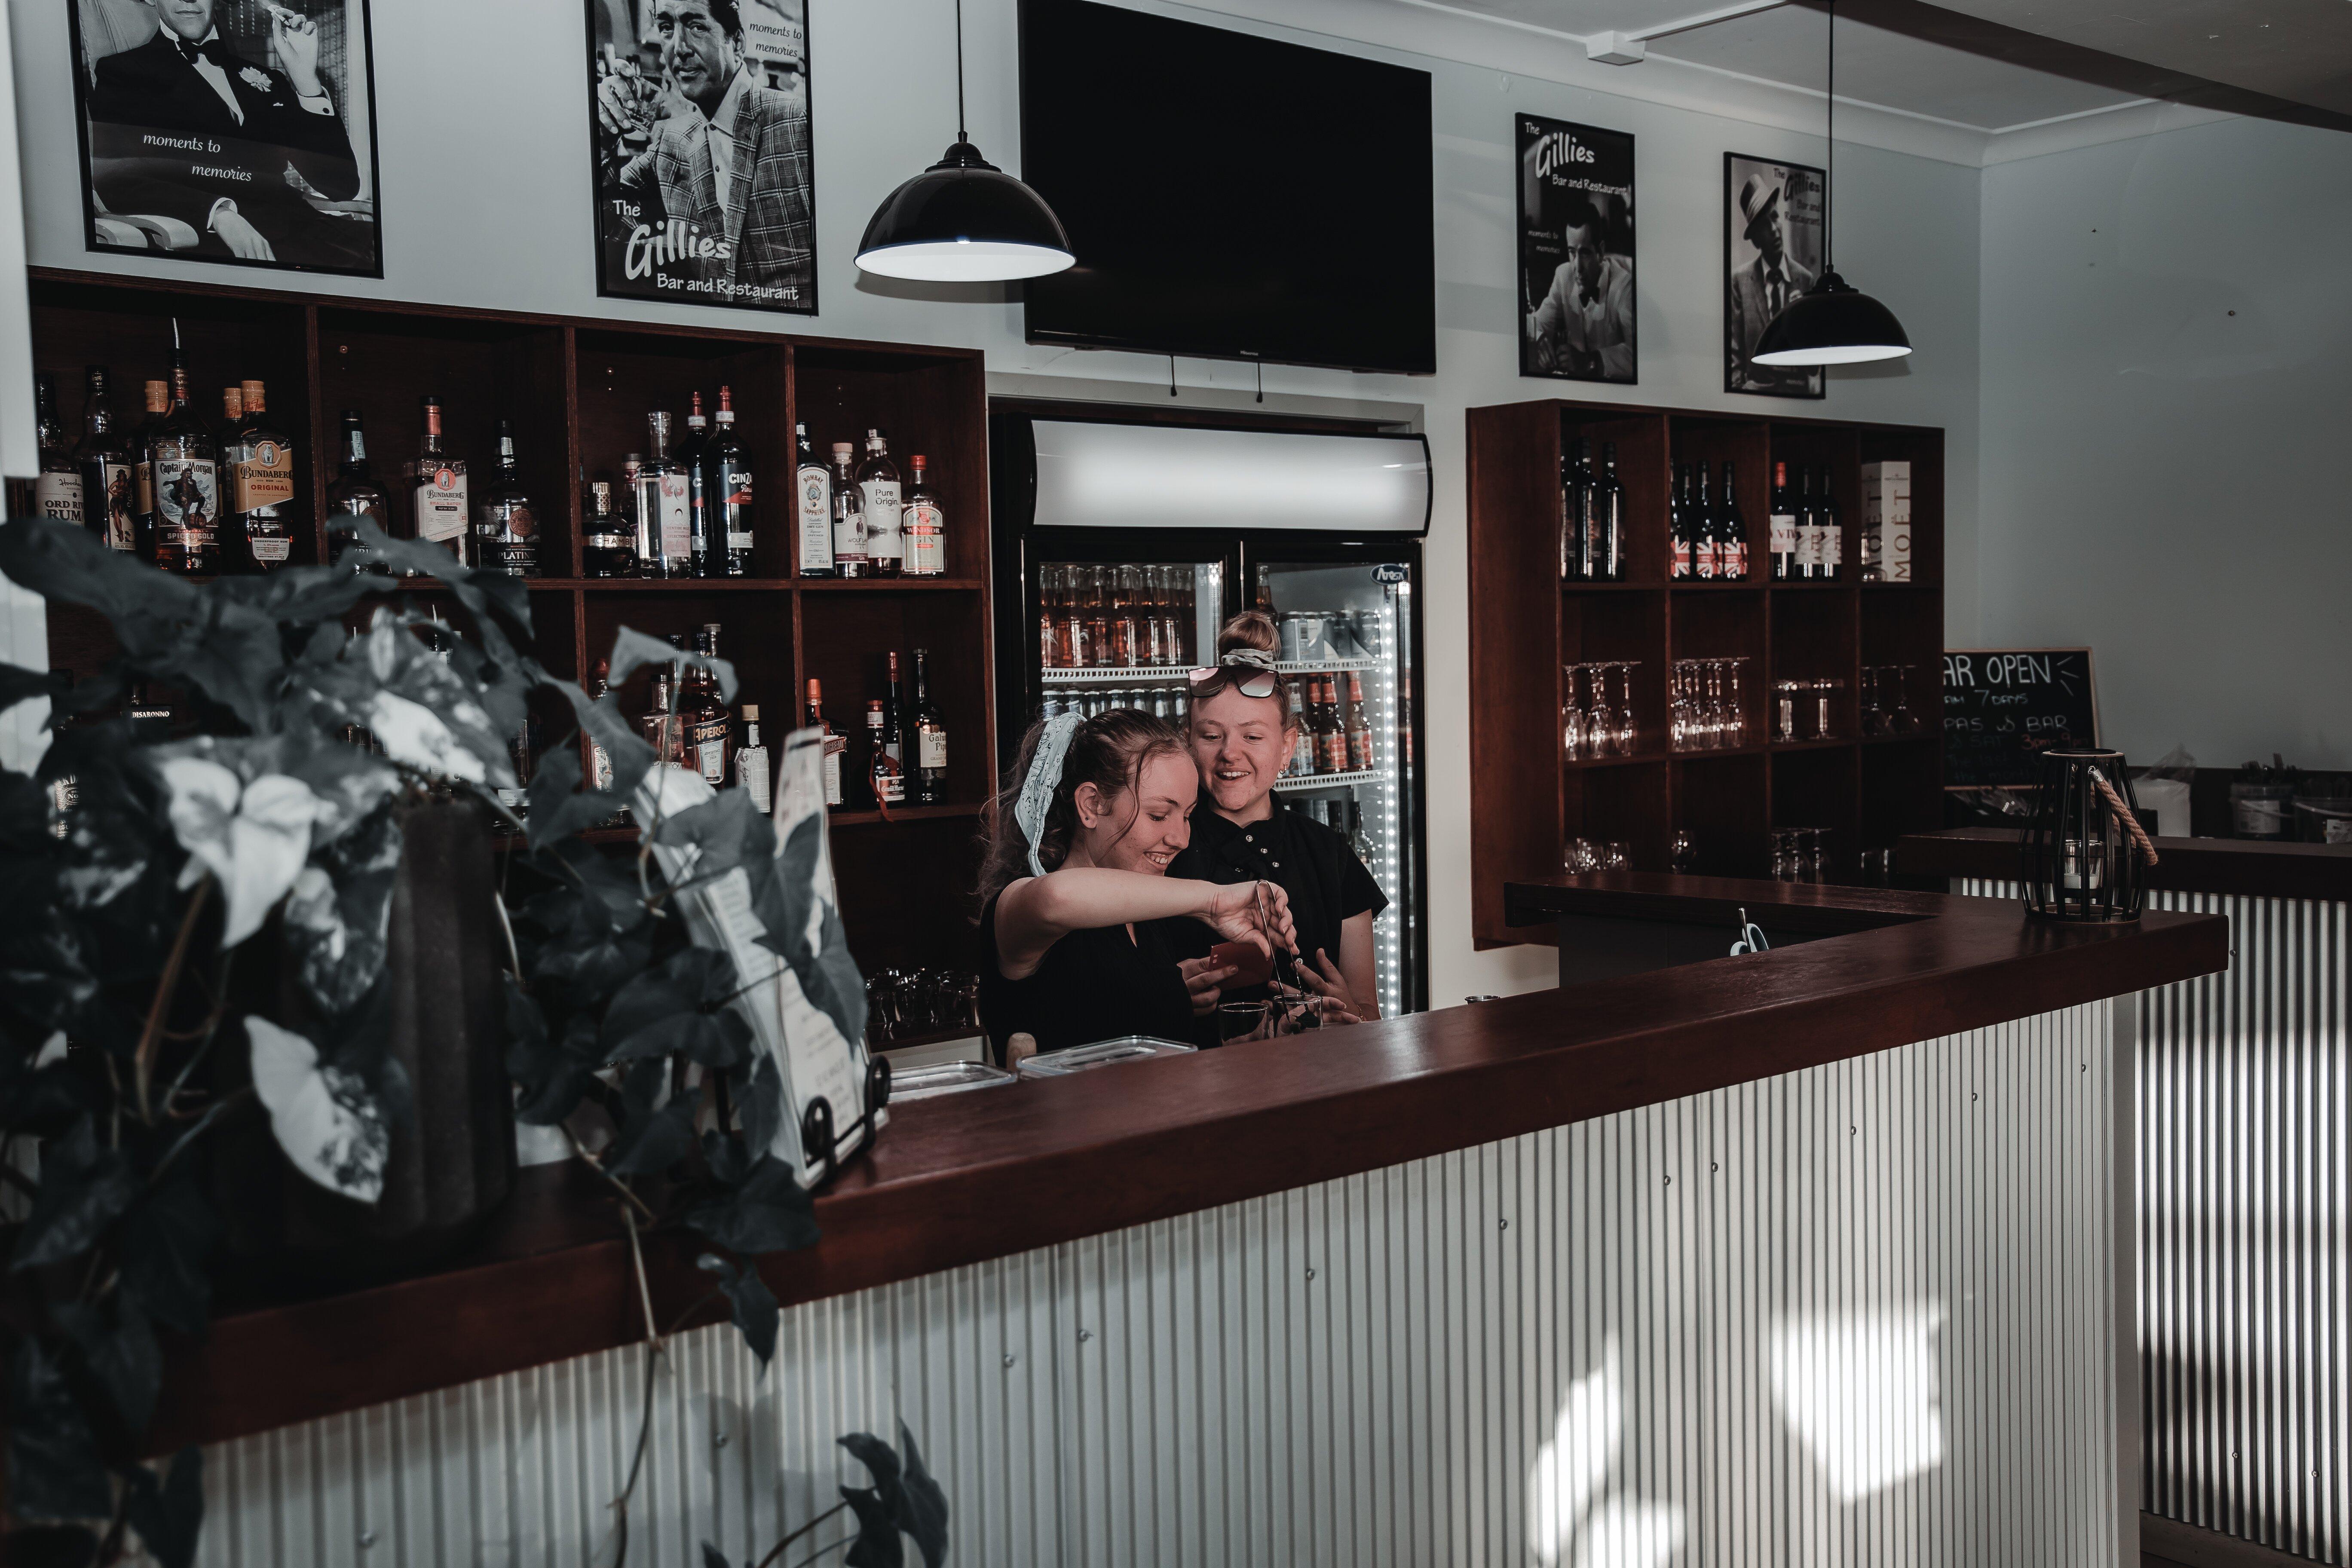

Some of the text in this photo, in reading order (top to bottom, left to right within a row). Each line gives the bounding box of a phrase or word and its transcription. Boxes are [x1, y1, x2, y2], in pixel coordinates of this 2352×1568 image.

[750, 21, 802, 40] moments to
[755, 42, 798, 57] memories
[1525, 122, 1540, 135] The
[144, 133, 220, 153] moments to
[1535, 132, 1595, 178] Gillies
[192, 164, 252, 182] memories
[1552, 174, 1627, 195] Bar and Restaurant
[613, 200, 640, 217] The
[625, 220, 731, 280] Gillies
[657, 273, 799, 300] Bar and Restaurant
[187, 462, 213, 475] Morgan
[803, 475, 824, 484] BOMBAY
[427, 489, 464, 499] BUNDABERG
[876, 497, 899, 506] Origin.
[46, 509, 81, 521] RUM
[804, 506, 826, 515] SAPPHIRE
[1987, 655, 2052, 689] OPEN
[1973, 689, 1989, 707] 7
[1991, 692, 2028, 705] DAYS
[2026, 715, 2070, 732] BAR
